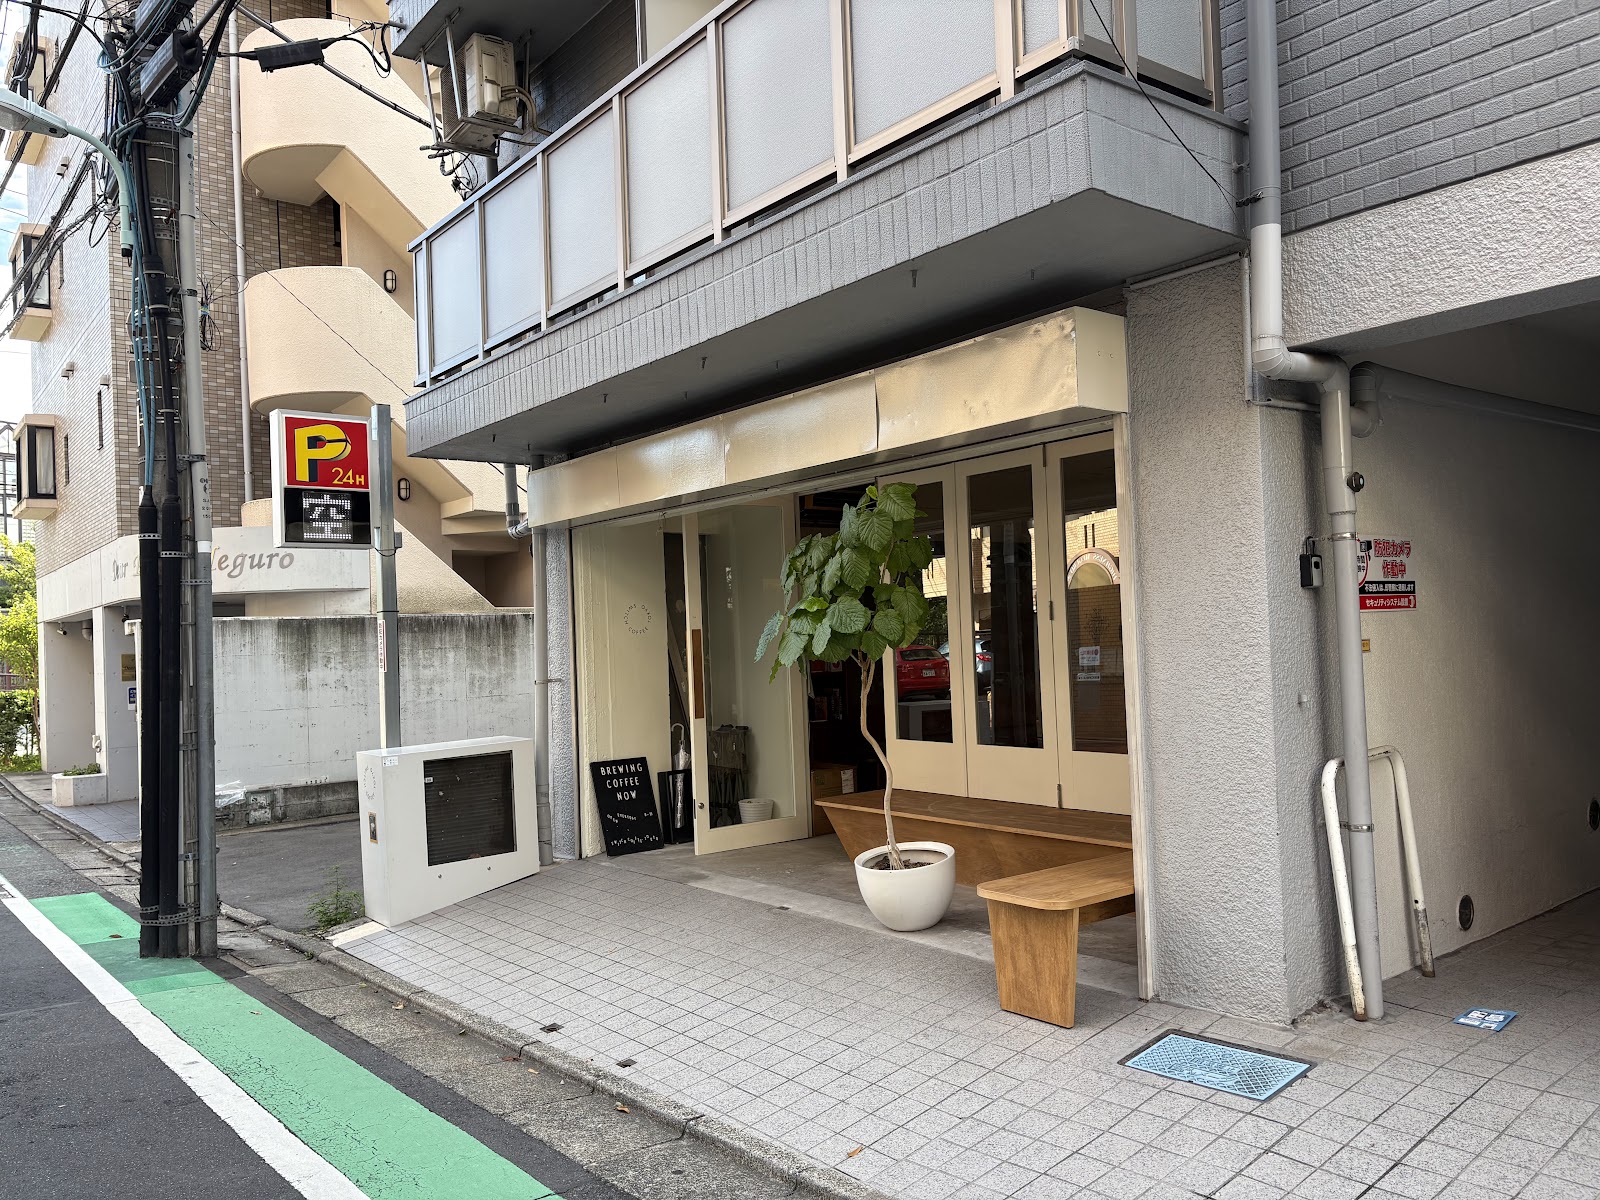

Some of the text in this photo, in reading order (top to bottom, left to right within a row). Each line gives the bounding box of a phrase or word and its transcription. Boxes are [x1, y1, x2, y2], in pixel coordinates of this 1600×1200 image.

[294, 424, 352, 483] P
[331, 467, 365, 486] 24H
[303, 494, 352, 540] 空
[1373, 538, 1412, 559] 防犯カメラ
[1382, 559, 1407, 579] 作動中
[600, 763, 643, 776] BREWING
[606, 776, 640, 789] COFFEE
[616, 789, 637, 801] NOW
